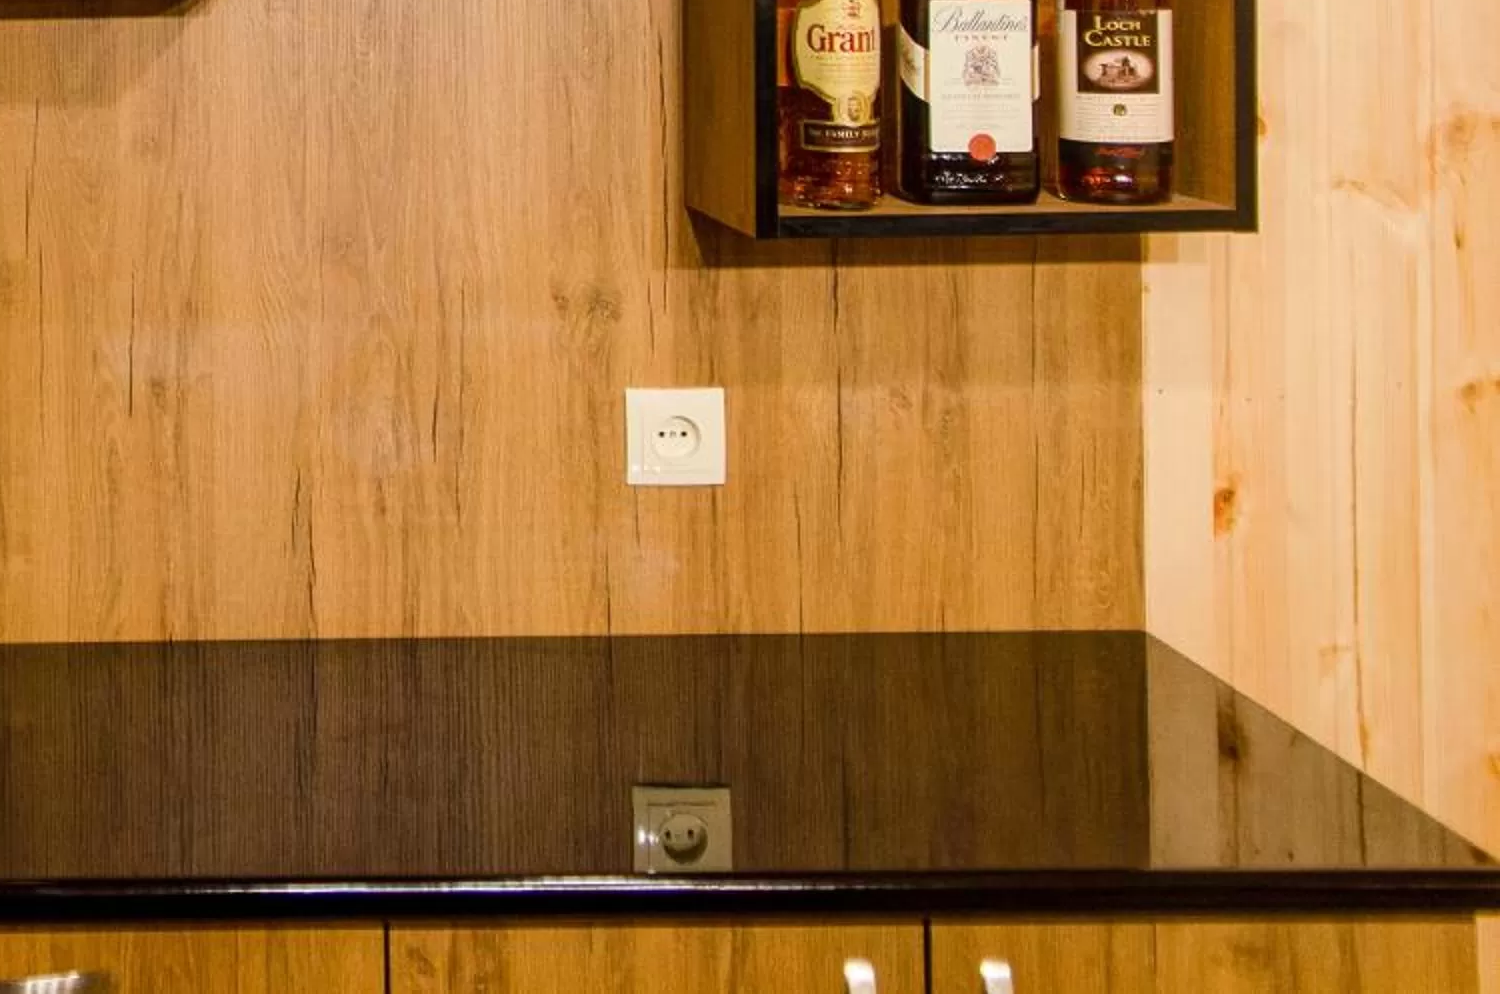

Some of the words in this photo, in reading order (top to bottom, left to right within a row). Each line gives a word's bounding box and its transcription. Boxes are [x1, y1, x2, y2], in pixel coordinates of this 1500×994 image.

[931, 6, 1032, 34] Ballantine's
[1092, 14, 1142, 32] LOCH
[1084, 29, 1152, 48] CASTLE
